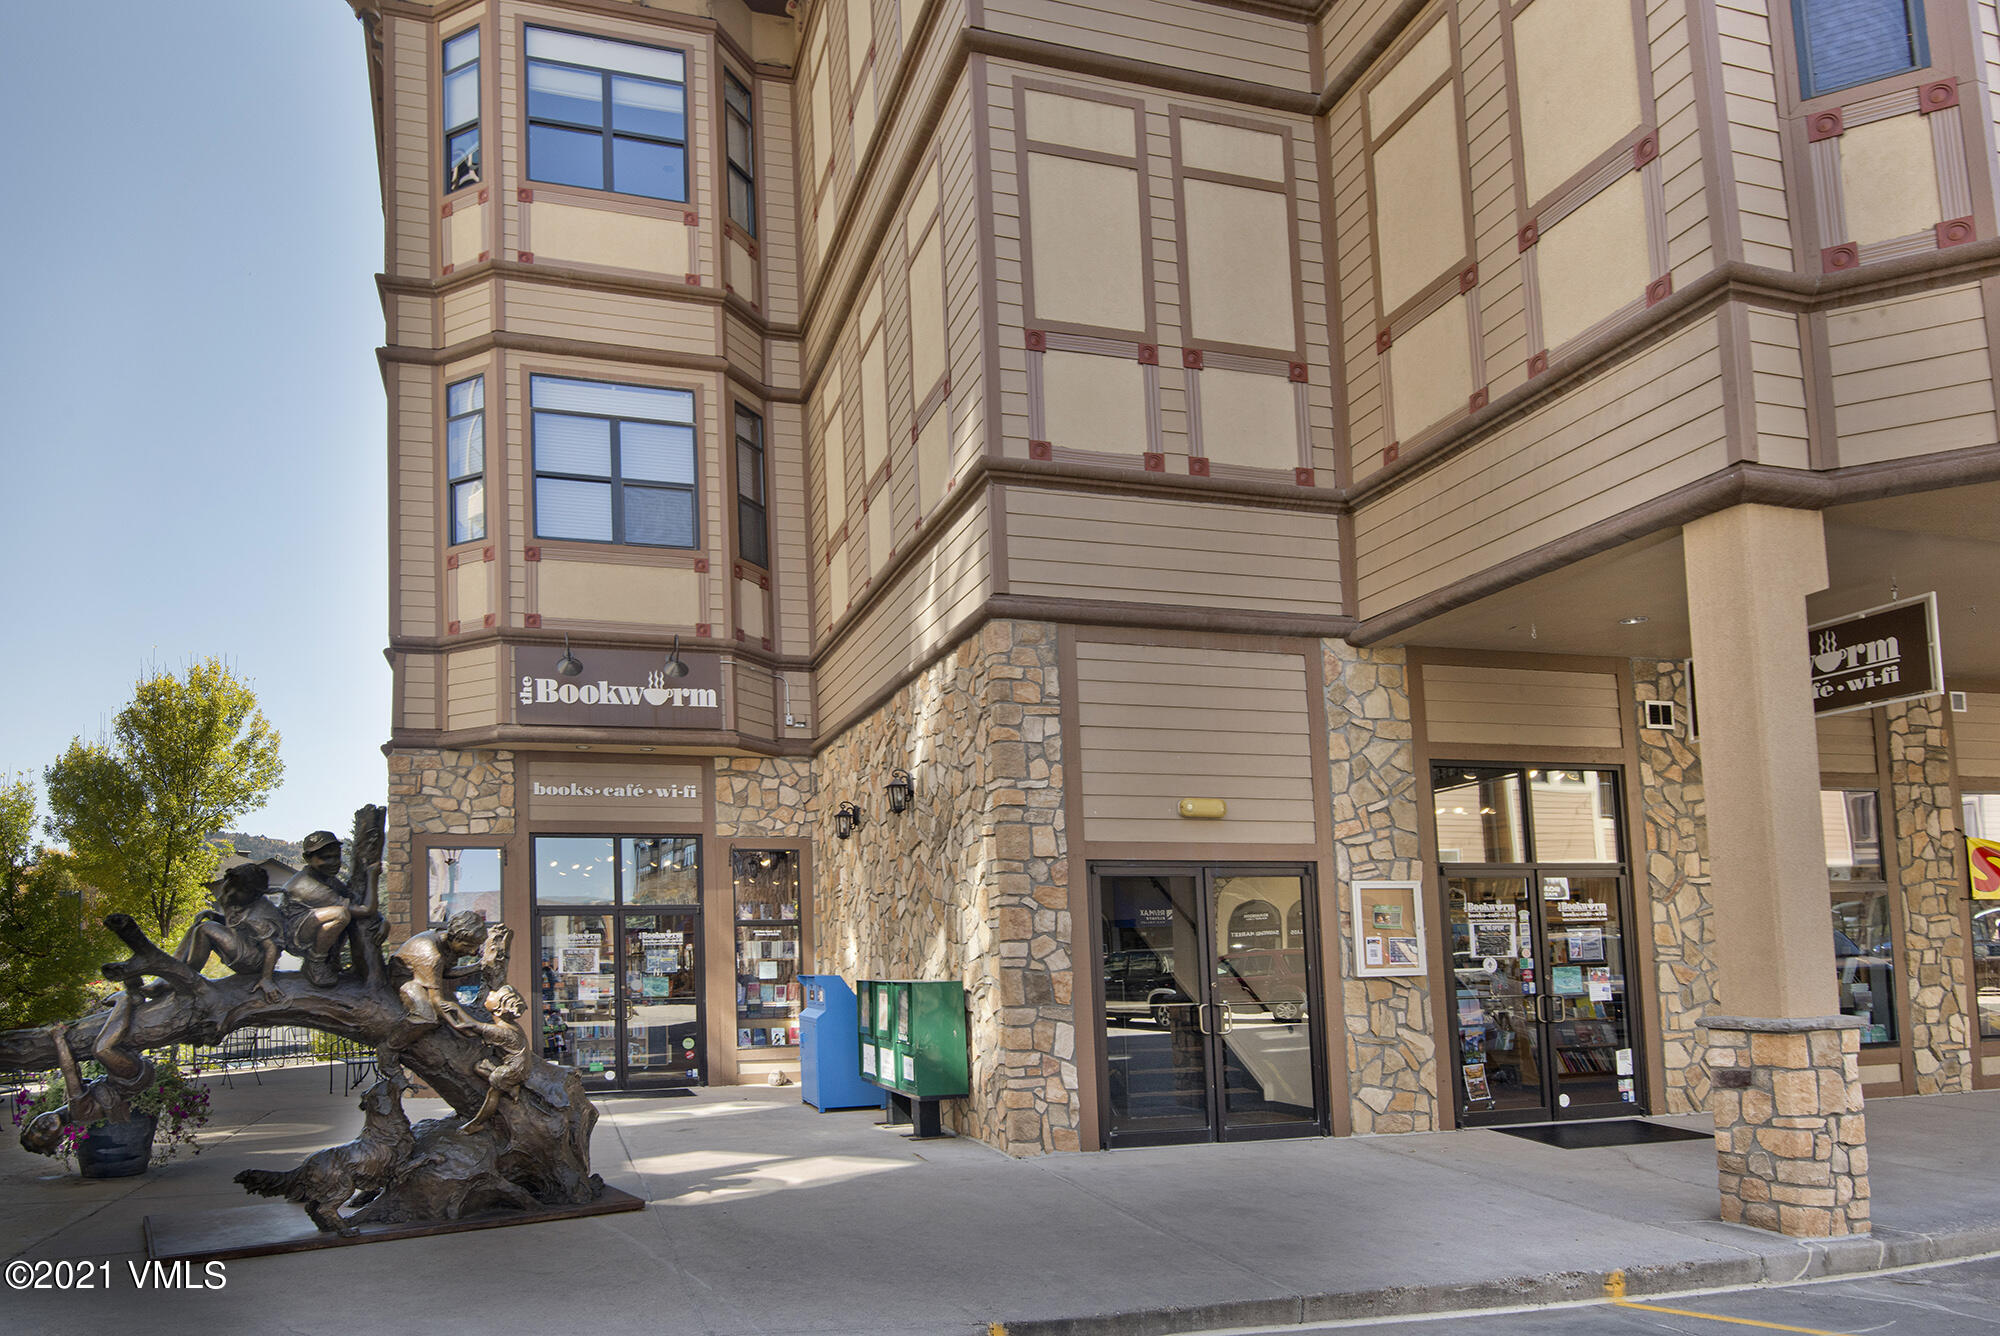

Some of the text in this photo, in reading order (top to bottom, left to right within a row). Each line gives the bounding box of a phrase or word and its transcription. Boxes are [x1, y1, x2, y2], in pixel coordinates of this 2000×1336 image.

[519, 675, 533, 705] the
[533, 782, 697, 798] books café wi-fi
